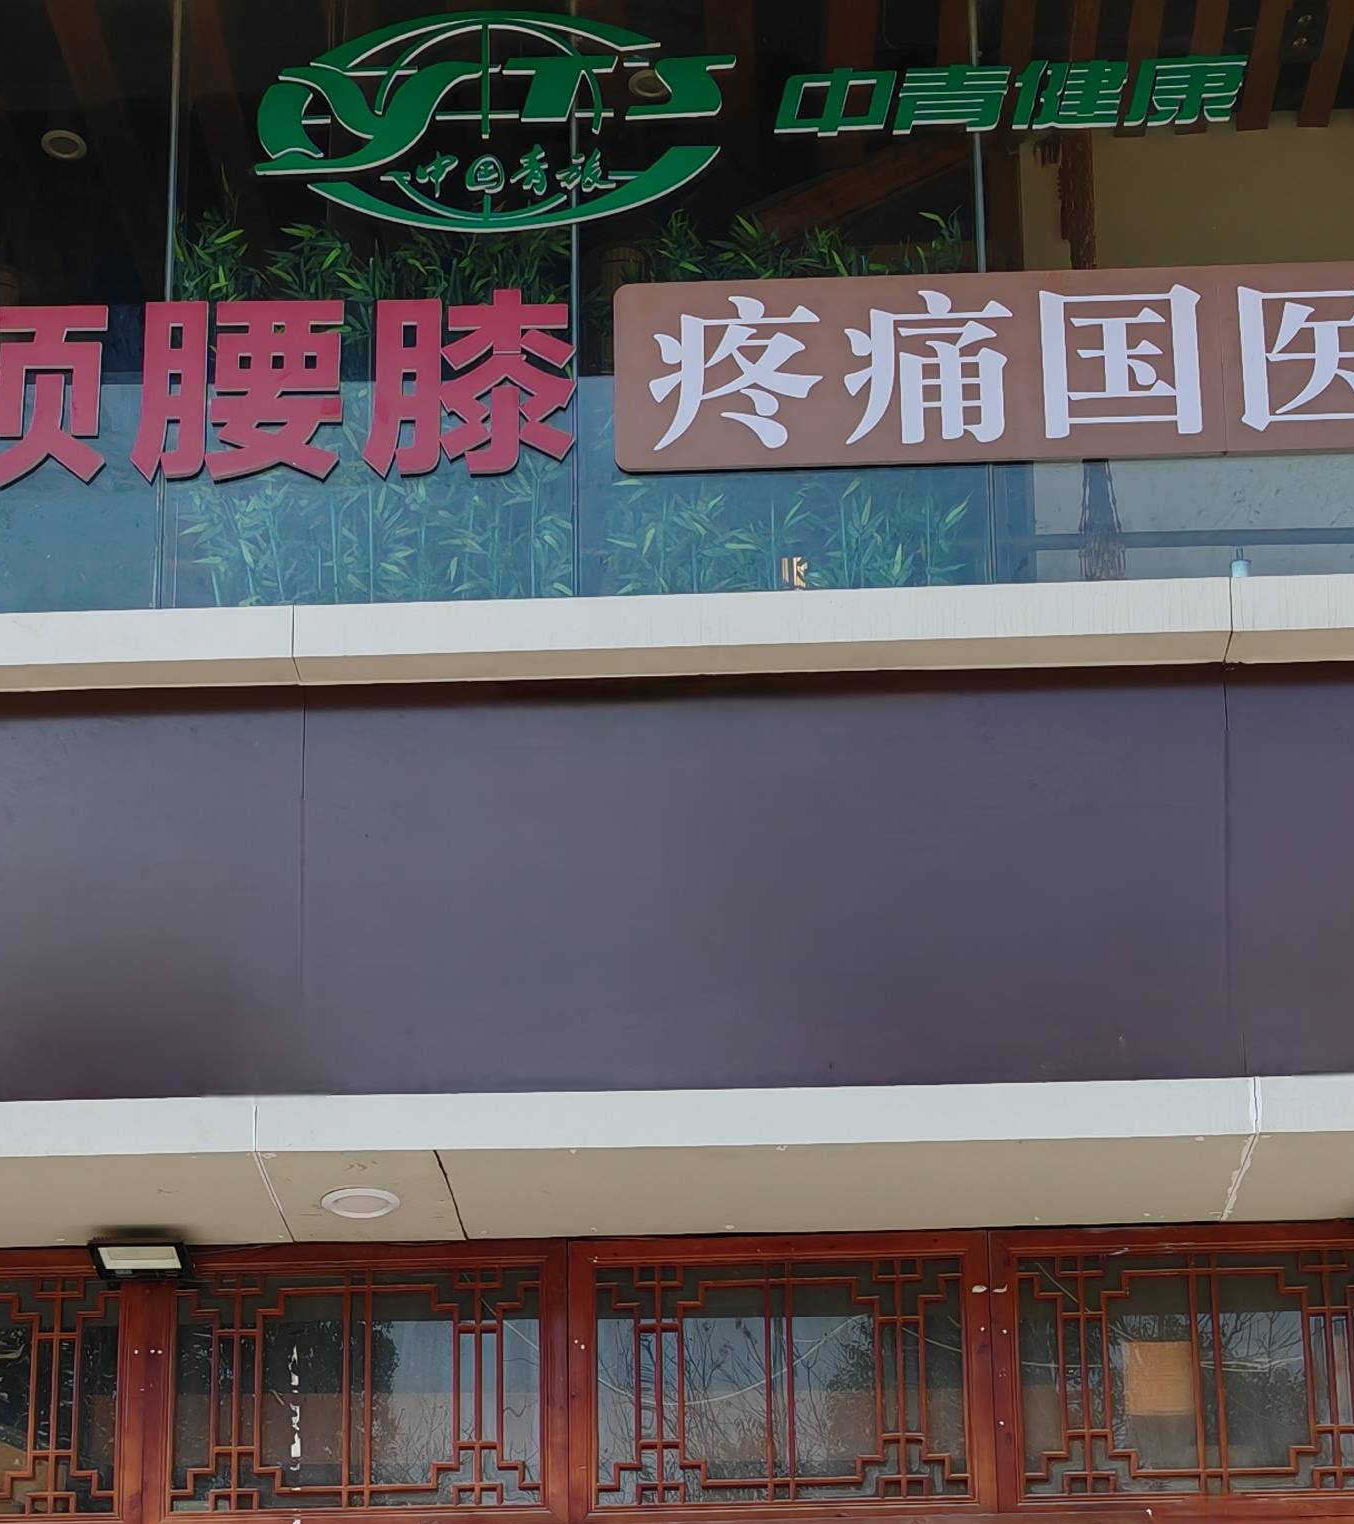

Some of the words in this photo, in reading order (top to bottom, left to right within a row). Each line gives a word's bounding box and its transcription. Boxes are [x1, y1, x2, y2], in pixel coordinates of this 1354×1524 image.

[774, 54, 1248, 137] 中青健康
[416, 144, 616, 198] 中国青旅
